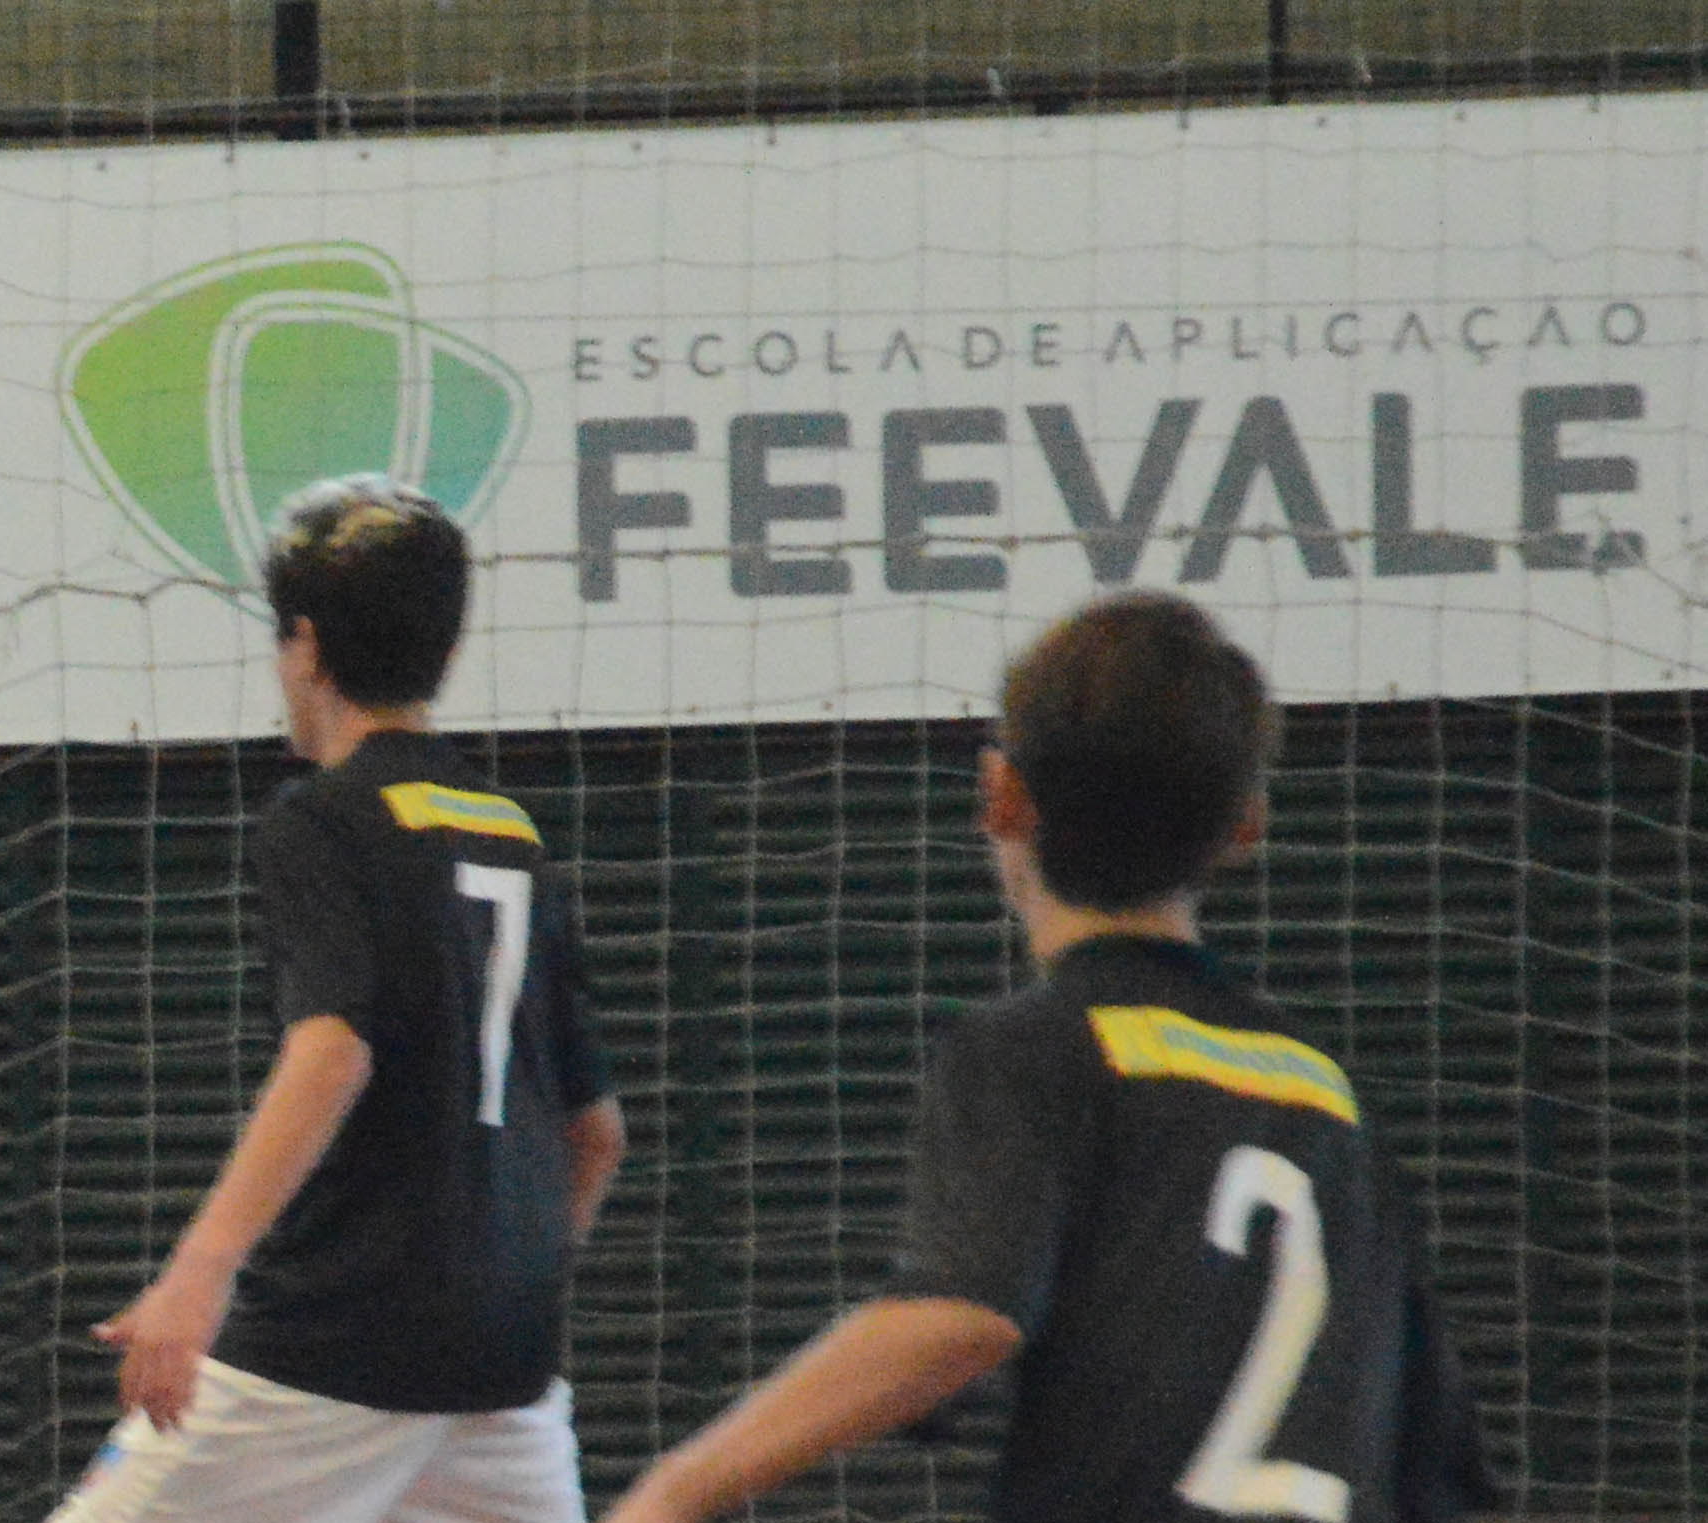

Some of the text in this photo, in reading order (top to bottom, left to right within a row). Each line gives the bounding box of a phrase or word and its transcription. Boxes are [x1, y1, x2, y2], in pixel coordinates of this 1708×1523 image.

[573, 330, 921, 382] ESCOLA
[962, 322, 1061, 370] DE
[576, 384, 1646, 602] FEEVALE
[454, 861, 533, 1127] 7
